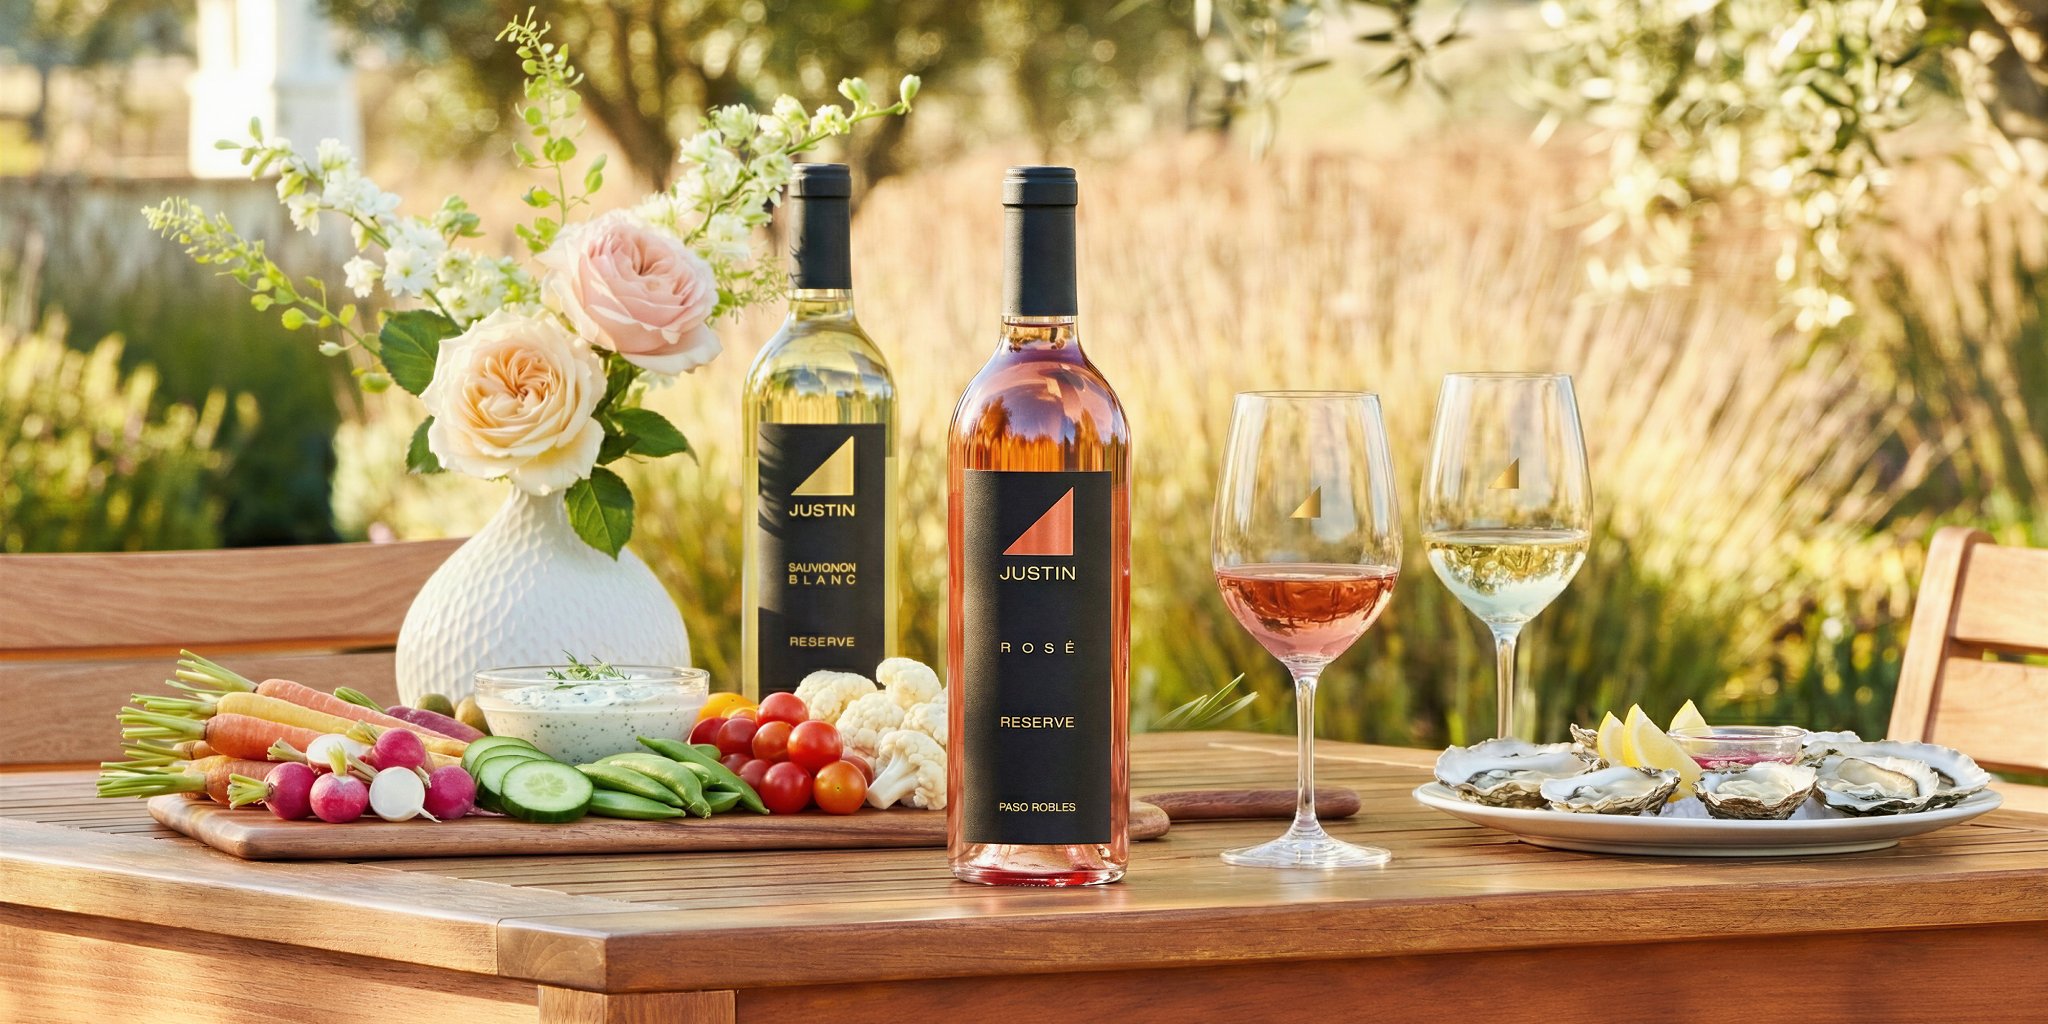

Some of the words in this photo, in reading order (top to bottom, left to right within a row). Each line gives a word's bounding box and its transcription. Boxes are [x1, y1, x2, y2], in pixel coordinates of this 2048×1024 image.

[788, 503, 856, 518] JUSTIN
[788, 573, 857, 585] BLANC
[999, 565, 1076, 581] JUSTIN
[789, 636, 855, 647] RESERVE
[1000, 639, 1075, 654] ROSÉ
[1000, 716, 1075, 729] RESERVE
[999, 802, 1029, 812] PASO
[1031, 802, 1076, 812] ROBLES
